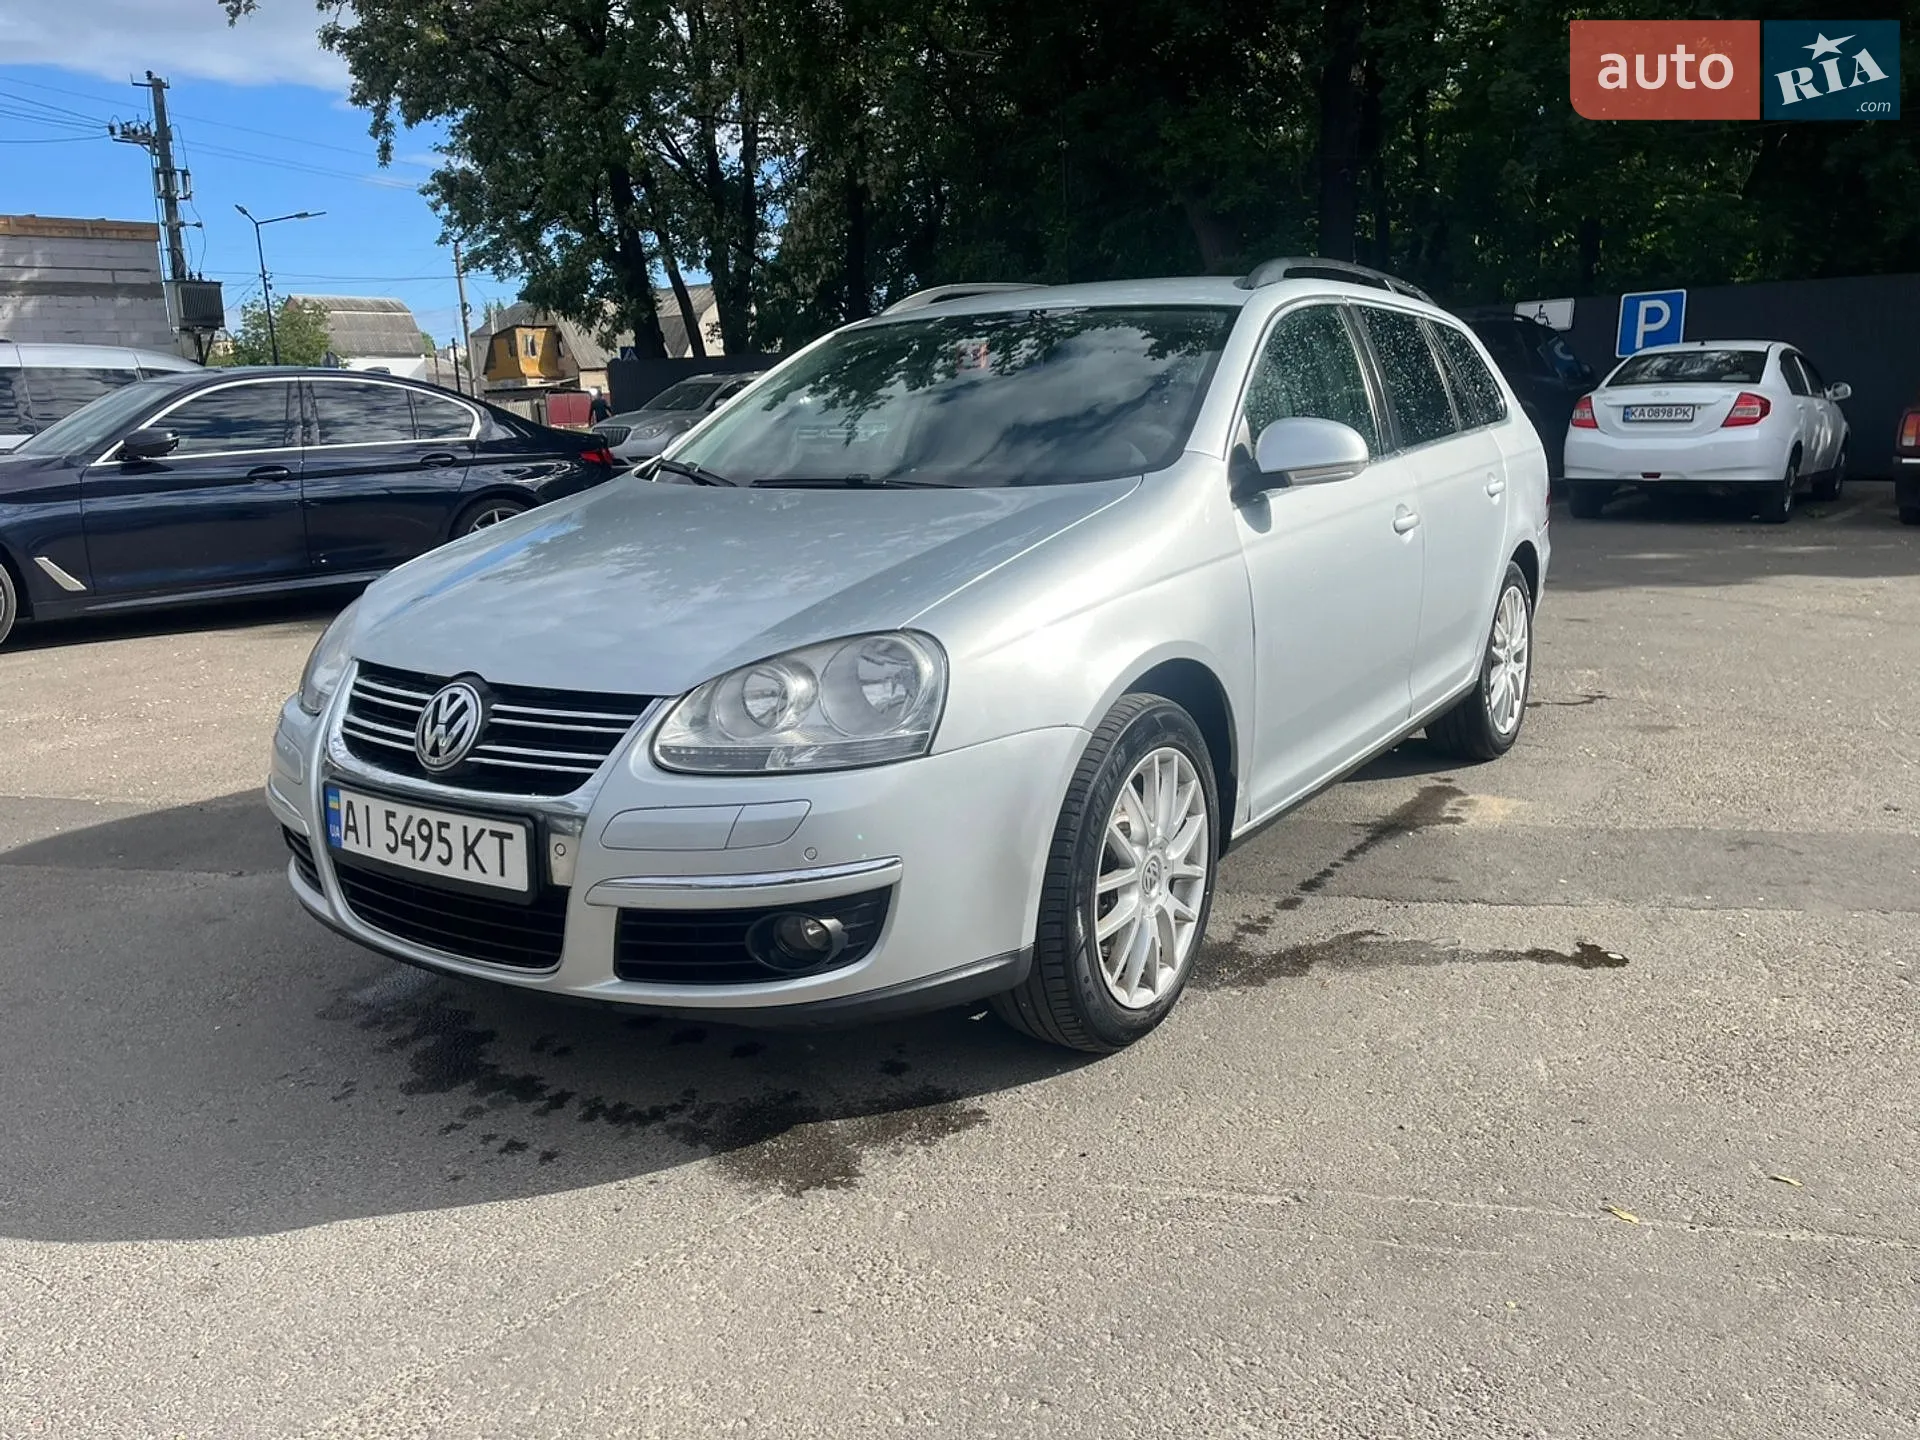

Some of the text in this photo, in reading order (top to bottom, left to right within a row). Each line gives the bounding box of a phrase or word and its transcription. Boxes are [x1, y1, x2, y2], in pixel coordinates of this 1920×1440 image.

[1635, 299, 1671, 350] P
[329, 824, 341, 838] UA
[343, 800, 514, 878] AI 5495 KT
